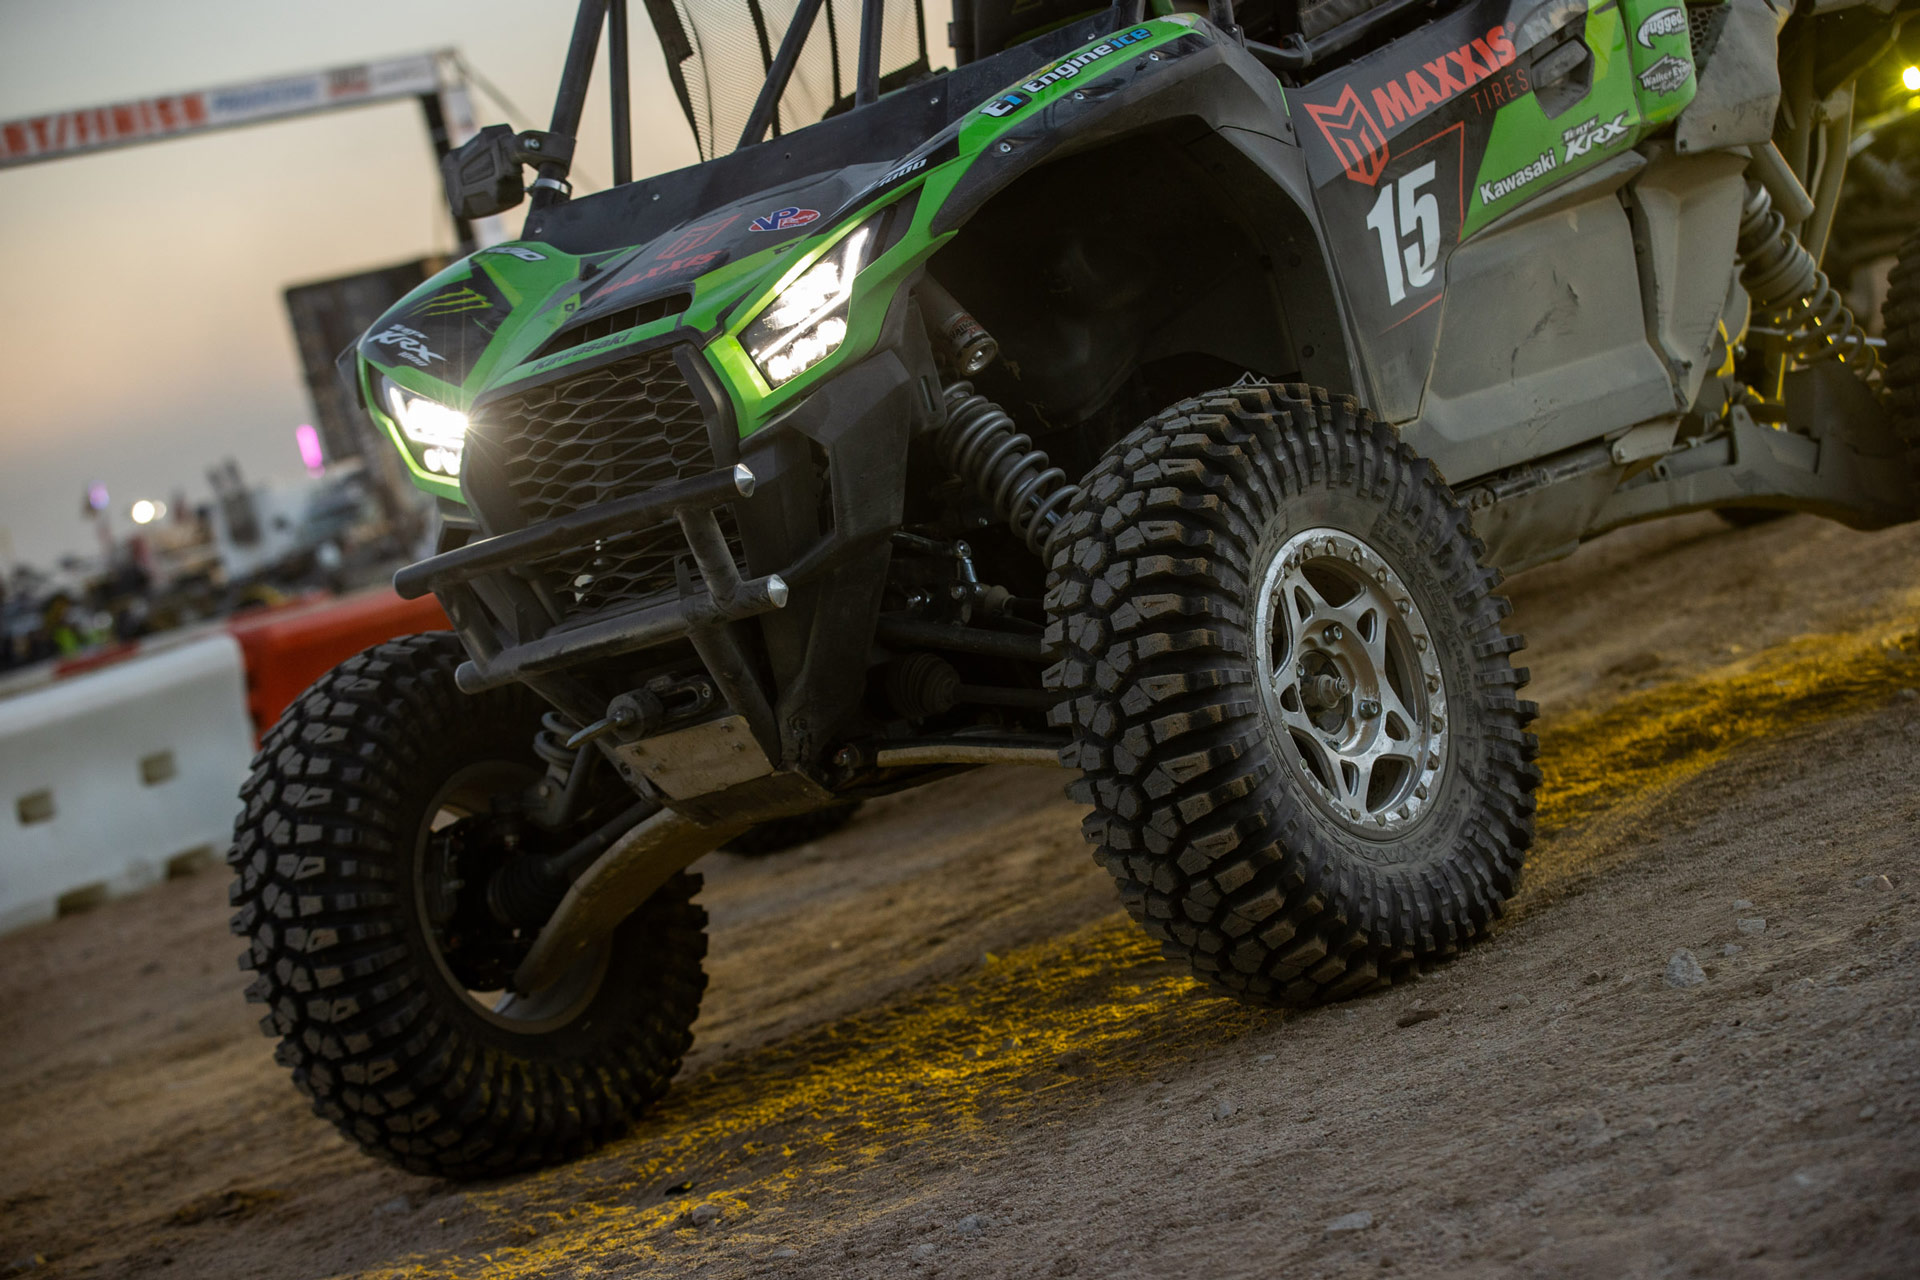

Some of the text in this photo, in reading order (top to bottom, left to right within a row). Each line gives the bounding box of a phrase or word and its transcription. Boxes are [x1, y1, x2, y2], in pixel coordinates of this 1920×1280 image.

[1371, 26, 1517, 129] MAXXIS
[1471, 69, 1529, 115] TIRES
[1642, 70, 1673, 89] Walker
[1564, 112, 1630, 164] KRX
[1479, 149, 1557, 205] Kawasaki
[753, 207, 800, 230] VP
[1366, 160, 1441, 307] 15
